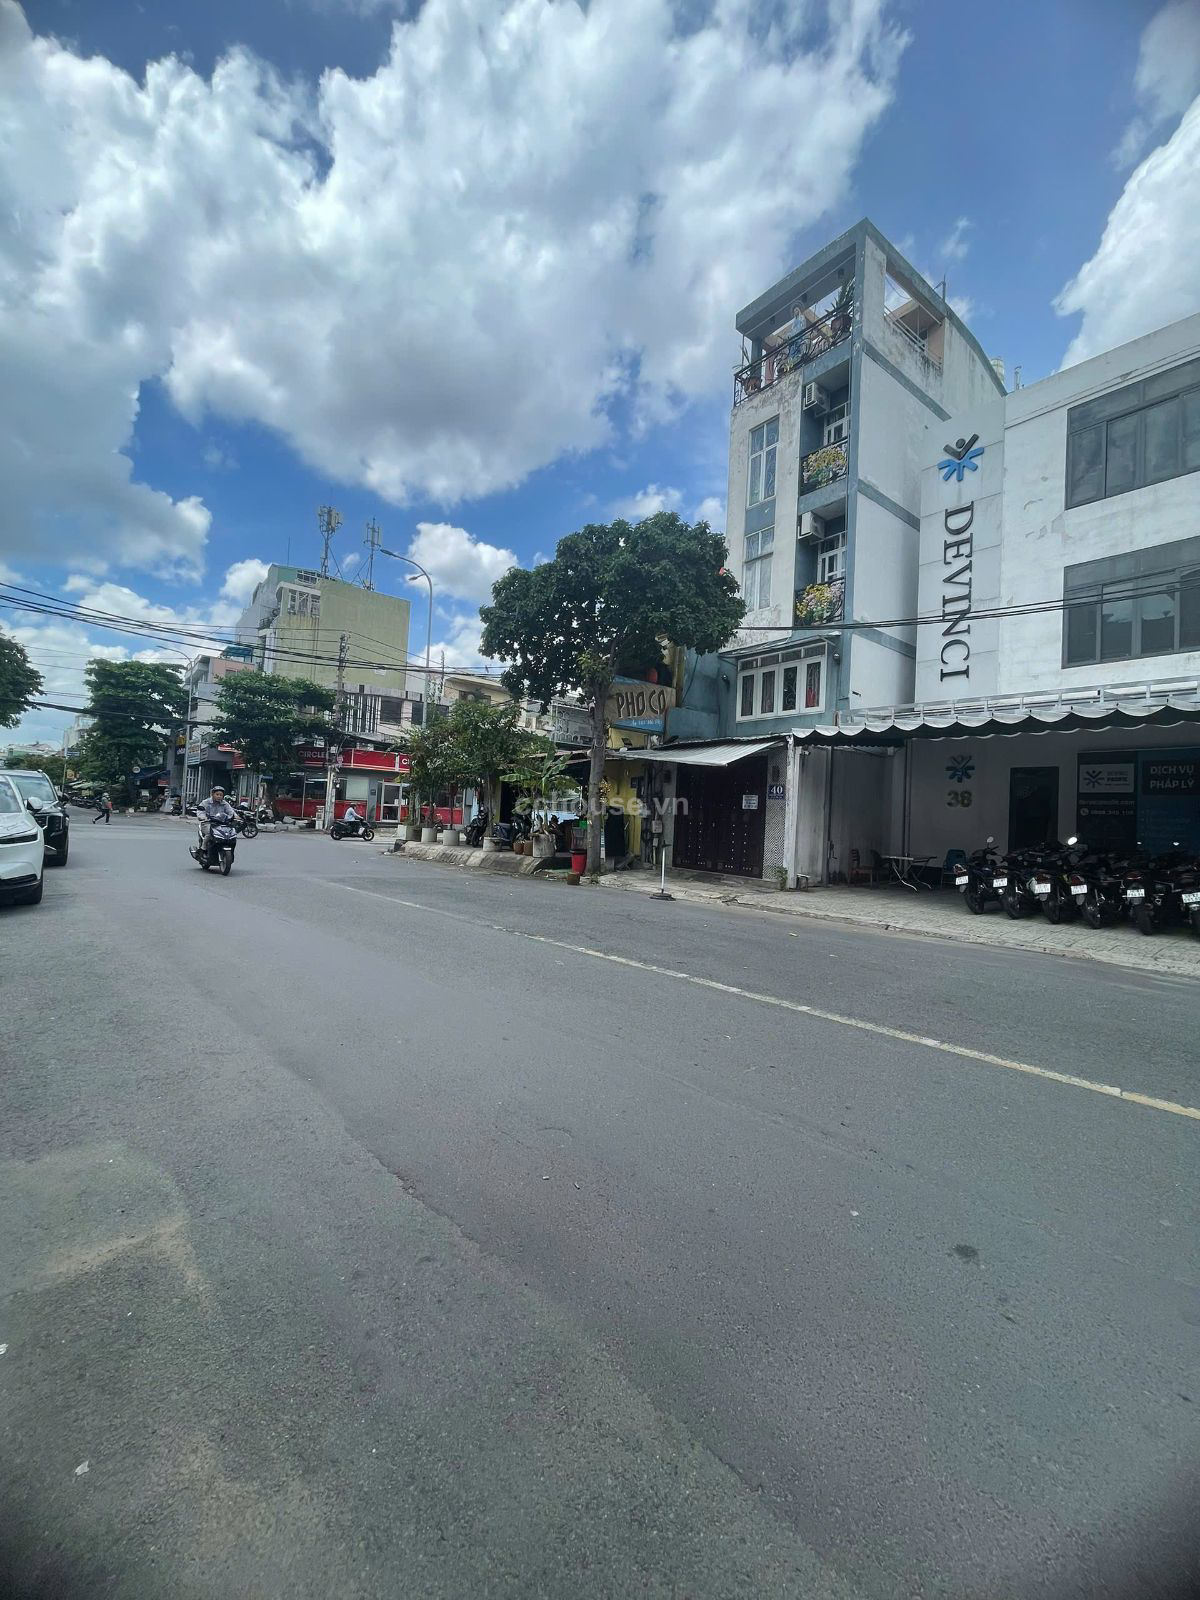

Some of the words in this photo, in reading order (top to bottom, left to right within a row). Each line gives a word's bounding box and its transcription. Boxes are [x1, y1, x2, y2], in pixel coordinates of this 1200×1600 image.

[940, 500, 974, 682] DEVINCI
[298, 750, 325, 759] CIRCLE
[770, 785, 783, 795] 40
[946, 790, 973, 808] 38
